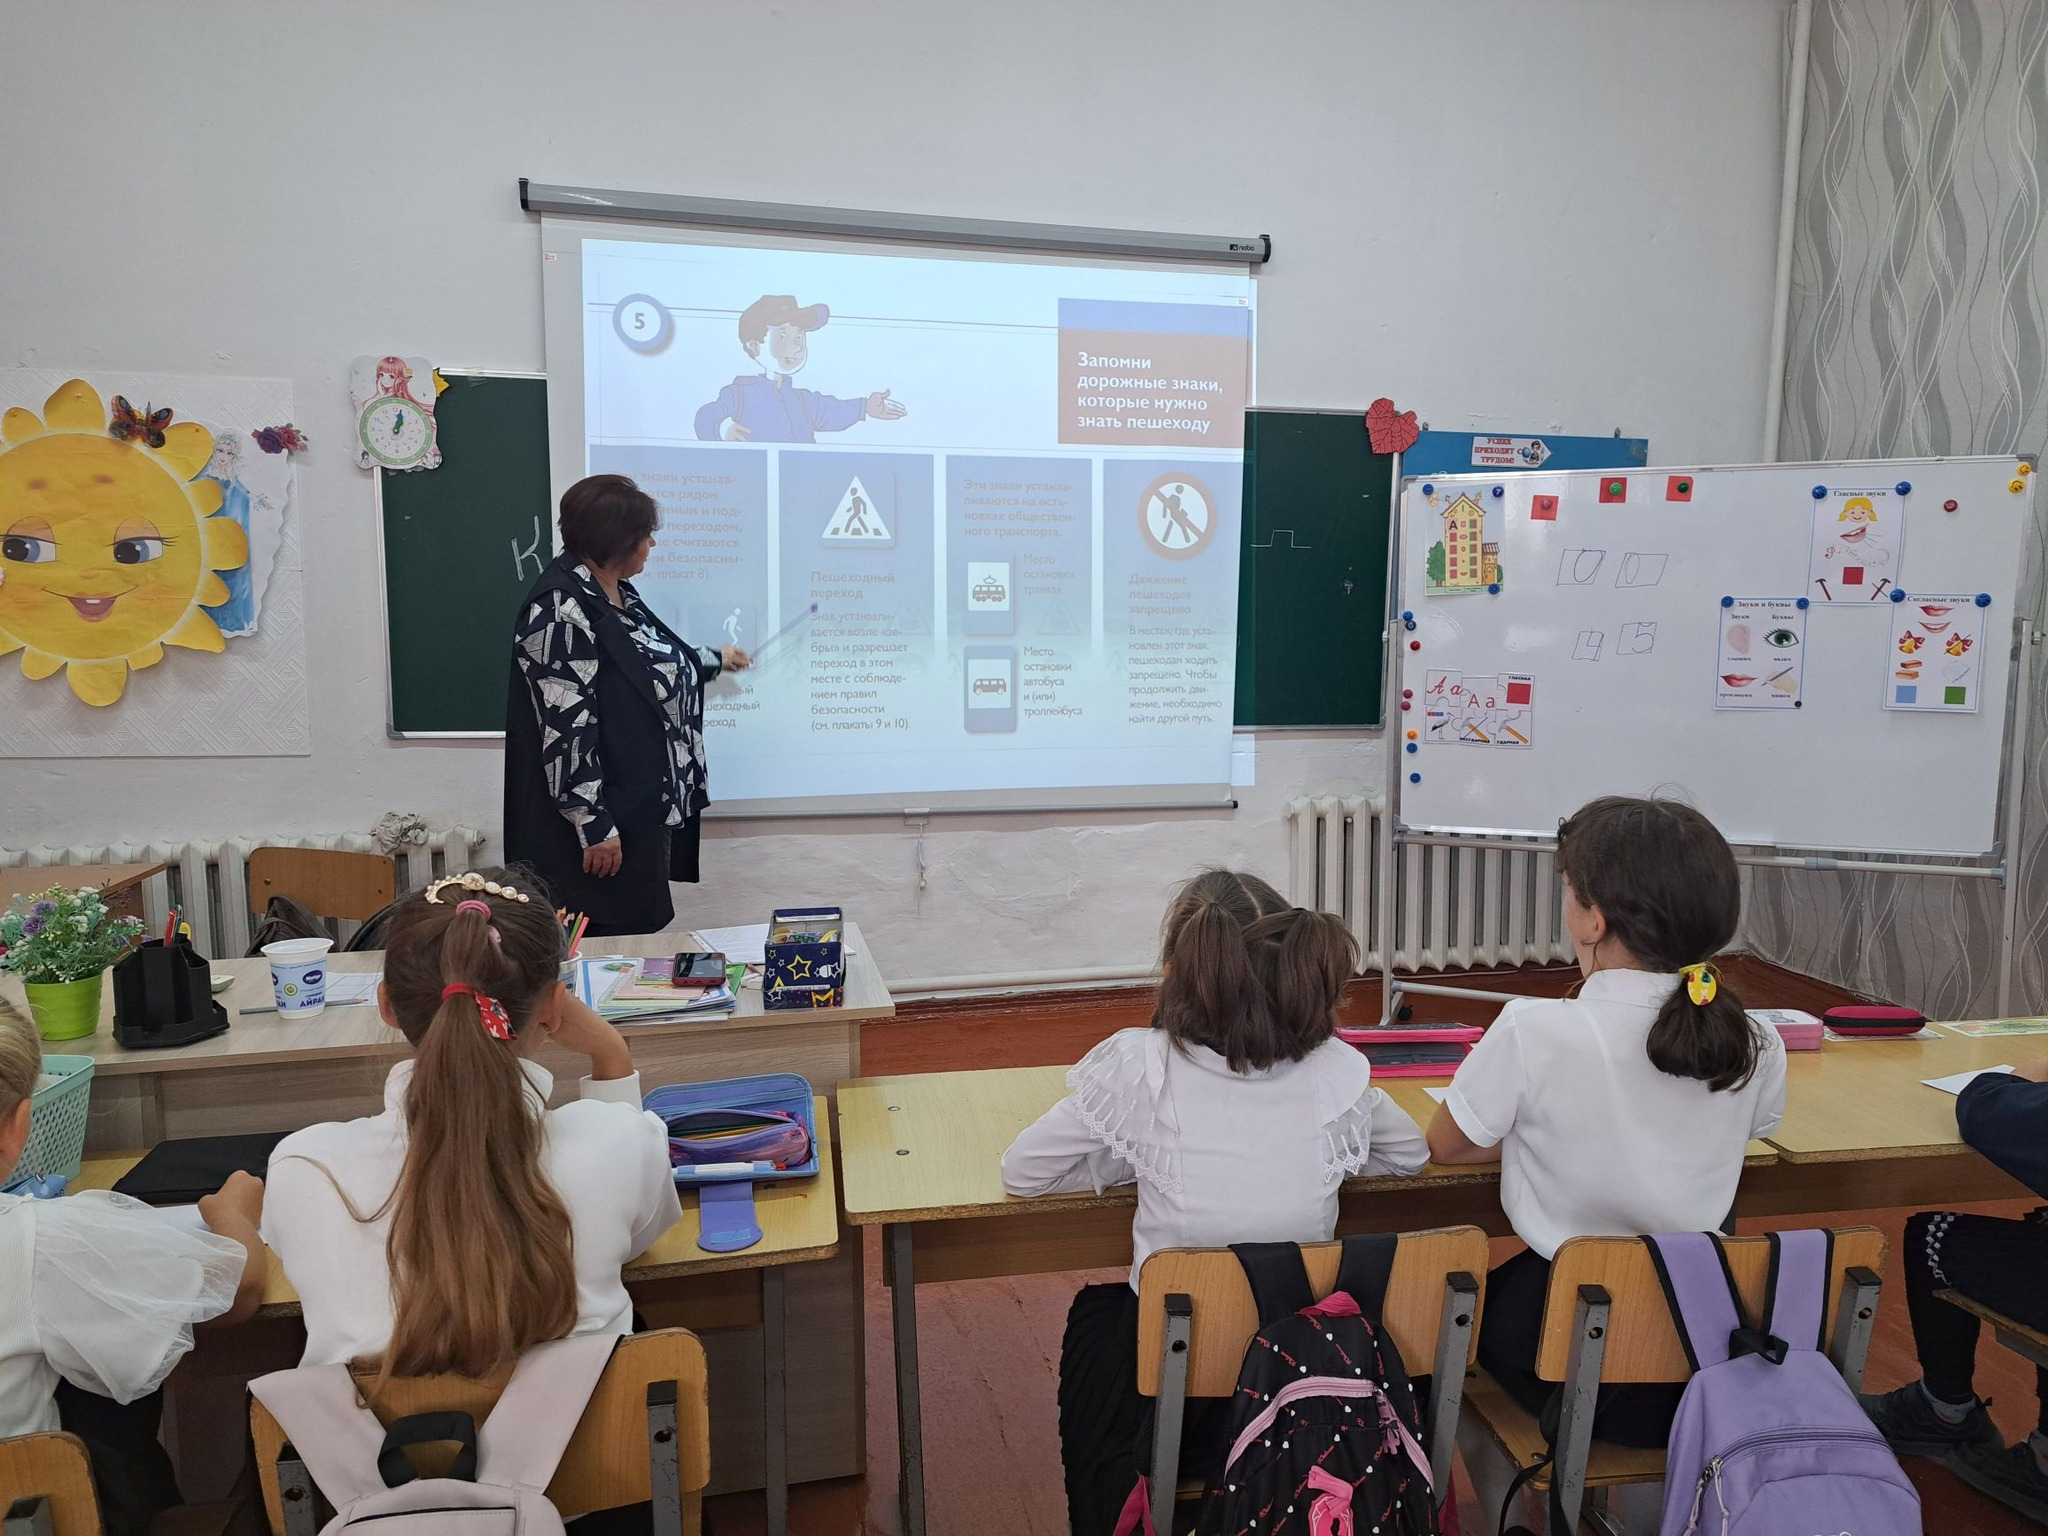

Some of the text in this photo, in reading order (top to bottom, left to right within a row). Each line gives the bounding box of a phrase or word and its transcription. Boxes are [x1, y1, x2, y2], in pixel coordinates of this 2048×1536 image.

[634, 312, 645, 330] 5
[1077, 351, 1152, 370] Запомни
[1077, 375, 1224, 394] дорожные знаки,
[1077, 396, 1208, 413] которые нужно
[1077, 415, 1211, 435] знать пешеходу
[1486, 437, 1512, 445] УСПЕХ
[1474, 447, 1516, 455] ПРИХОДИТ
[1481, 456, 1515, 464] ТРУДОМ!
[678, 489, 719, 503] рядом
[1833, 489, 1865, 497] Гласные
[810, 571, 895, 584] Пешеходный
[1129, 573, 1189, 585] Движение
[810, 590, 864, 601] переход
[1129, 590, 1192, 601] пешеходов
[1907, 595, 1948, 604] Согласные
[1738, 601, 1760, 609] Звуки
[1767, 601, 1791, 609] буквы
[1129, 606, 1192, 617] запрещено
[1731, 613, 1750, 621] Звуки
[1772, 613, 1794, 621] Буквы
[810, 628, 845, 638] вается
[847, 628, 879, 638] возле
[1174, 627, 1191, 637] где
[852, 643, 909, 654] разрешает
[1129, 641, 1163, 650] новлен
[1165, 641, 1185, 650] этот
[1023, 646, 1055, 657] Место
[810, 658, 857, 670] переход
[869, 658, 894, 668] этом
[1129, 656, 1219, 666] пешеходам ходить
[1023, 663, 1073, 672] остановки
[1185, 668, 1218, 680] Чтобы
[810, 675, 842, 685] месте
[1023, 675, 1066, 689] автобуса
[810, 689, 878, 701] нием правил
[1129, 684, 1187, 696] продолжить
[1031, 690, 1057, 704] (или)
[1163, 698, 1223, 709] необходимо
[810, 704, 886, 716] безопасности
[1023, 705, 1084, 719] троллейбуса
[1129, 712, 1156, 724] найти
[1157, 712, 1191, 725] другой
[811, 719, 830, 733] (см.
[832, 721, 874, 731] плакаты
